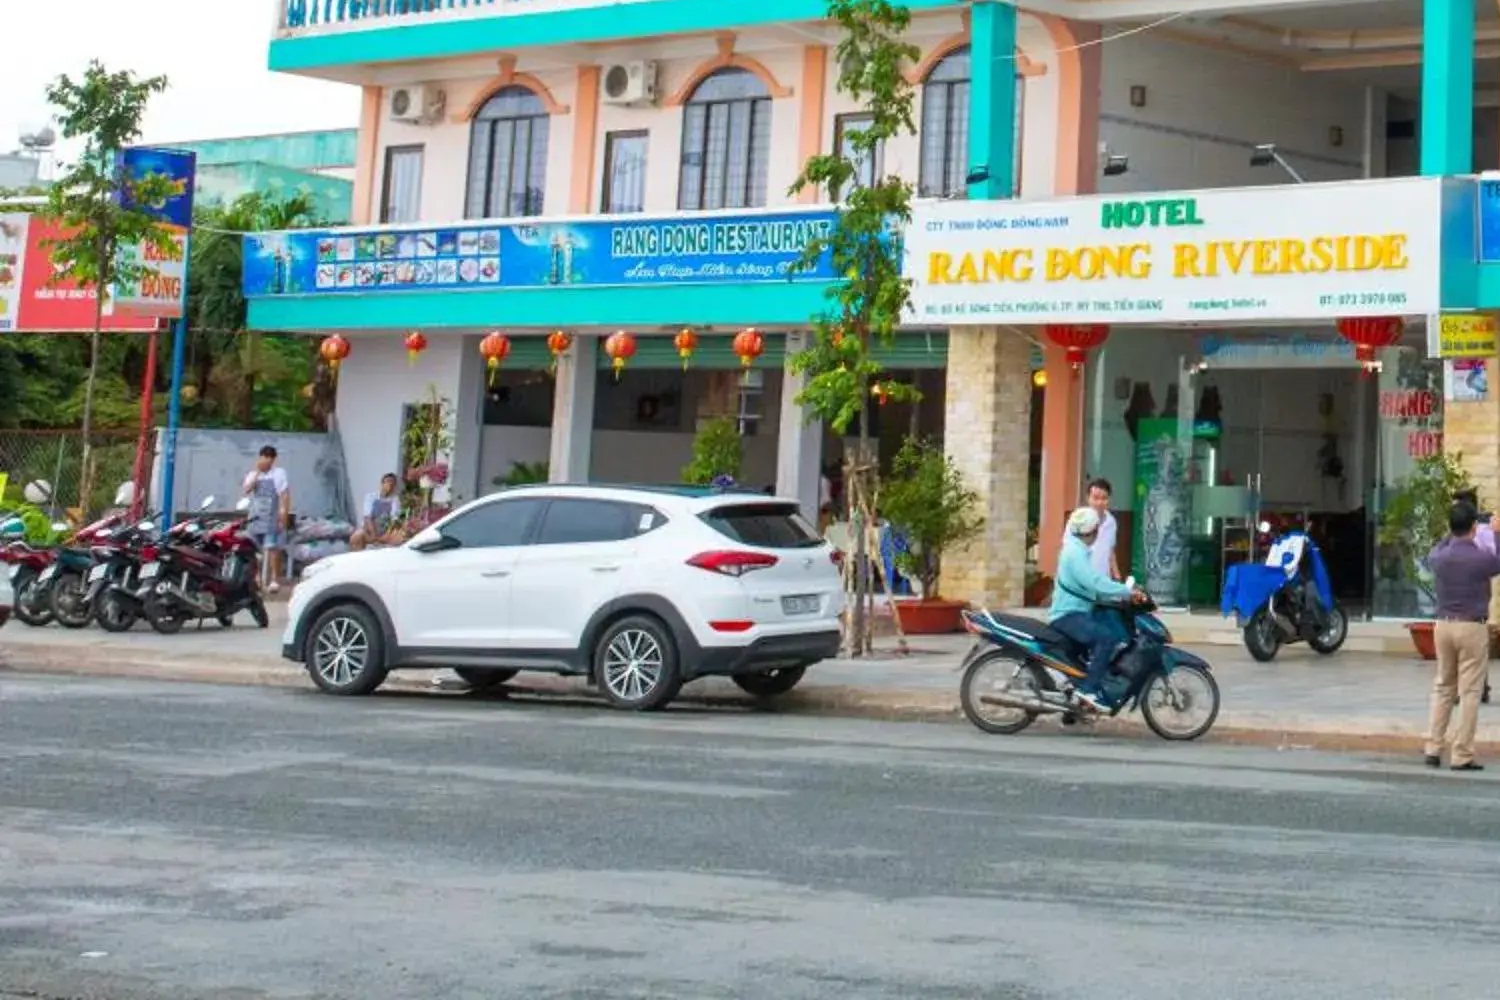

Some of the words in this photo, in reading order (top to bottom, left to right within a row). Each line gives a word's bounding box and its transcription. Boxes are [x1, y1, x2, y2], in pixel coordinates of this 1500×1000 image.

[1101, 199, 1205, 229] HOTEL
[612, 226, 659, 257] RANG
[662, 225, 711, 254] DONG
[713, 220, 831, 254] RESTAURANT
[927, 247, 1035, 286] RANG
[1171, 233, 1410, 279] RIVERSIDE
